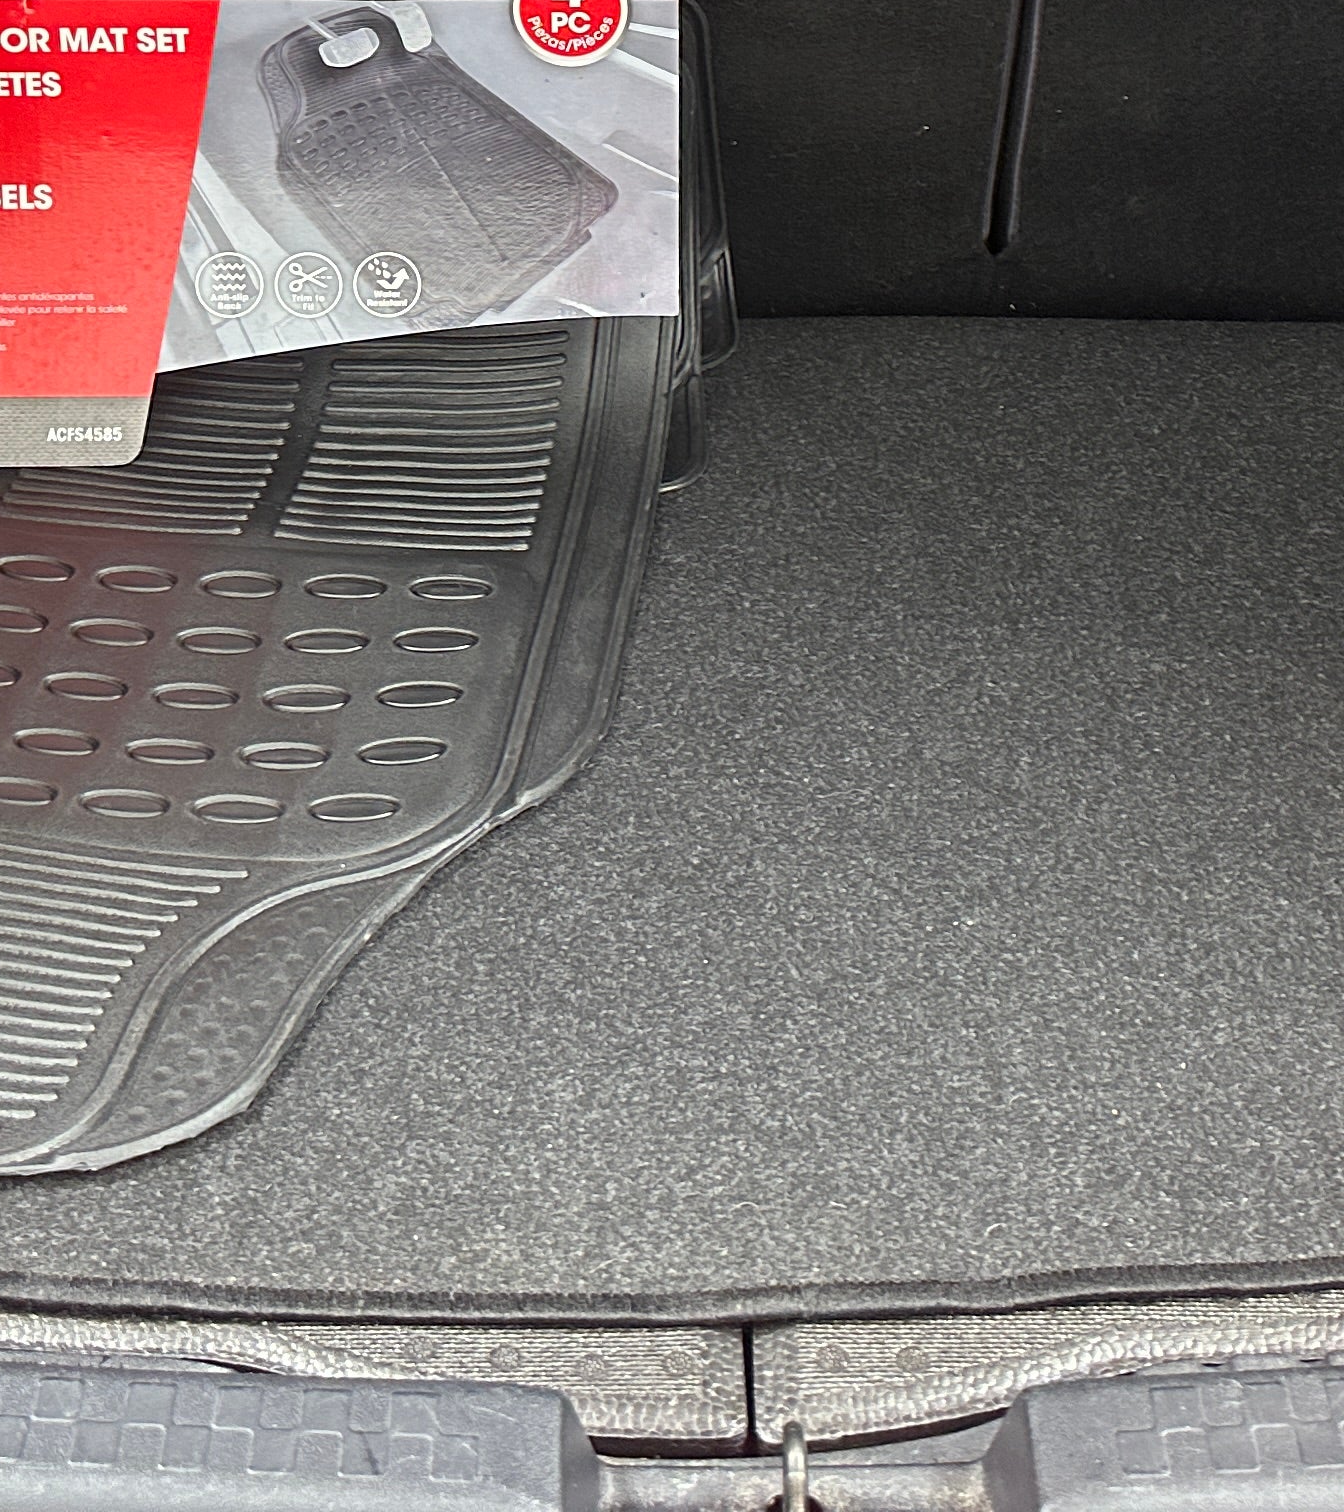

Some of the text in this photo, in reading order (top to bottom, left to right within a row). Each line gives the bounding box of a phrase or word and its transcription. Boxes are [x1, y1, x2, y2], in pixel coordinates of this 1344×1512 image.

[551, 11, 591, 34] PC
[58, 27, 128, 53] MAT
[136, 27, 190, 53] SET
[527, 15, 615, 52] Piezas/Pièces
[210, 293, 249, 303] Anti-slip
[291, 294, 325, 302] Trim to
[46, 427, 123, 442] ACFS4585
